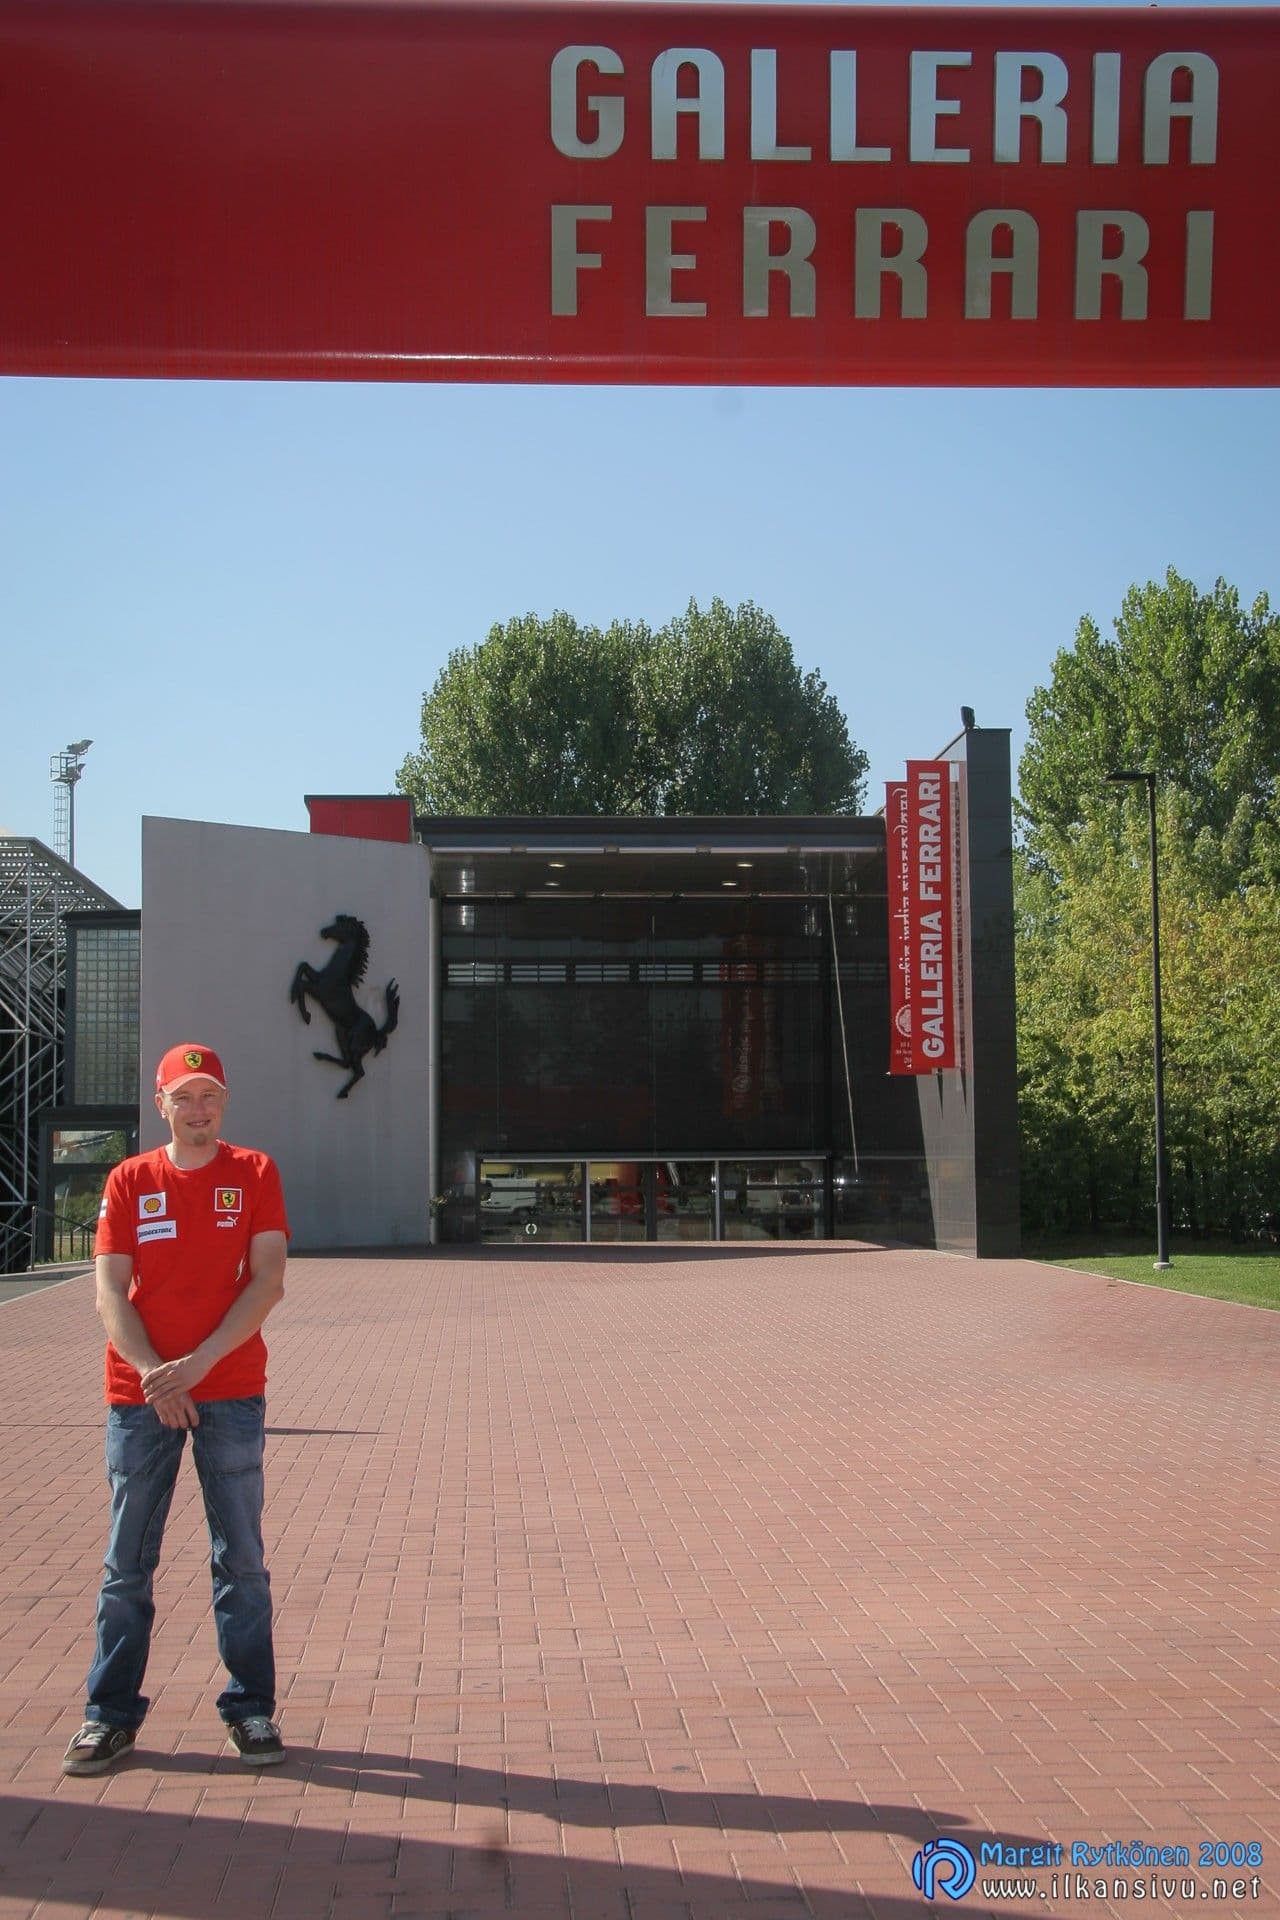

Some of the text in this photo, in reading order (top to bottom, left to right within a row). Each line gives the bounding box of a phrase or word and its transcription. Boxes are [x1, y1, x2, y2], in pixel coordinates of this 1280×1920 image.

[550, 45, 1219, 165] GALLERIA
[550, 205, 1214, 320] FERRARI
[918, 771, 945, 1058] GALLERIA FERRARI
